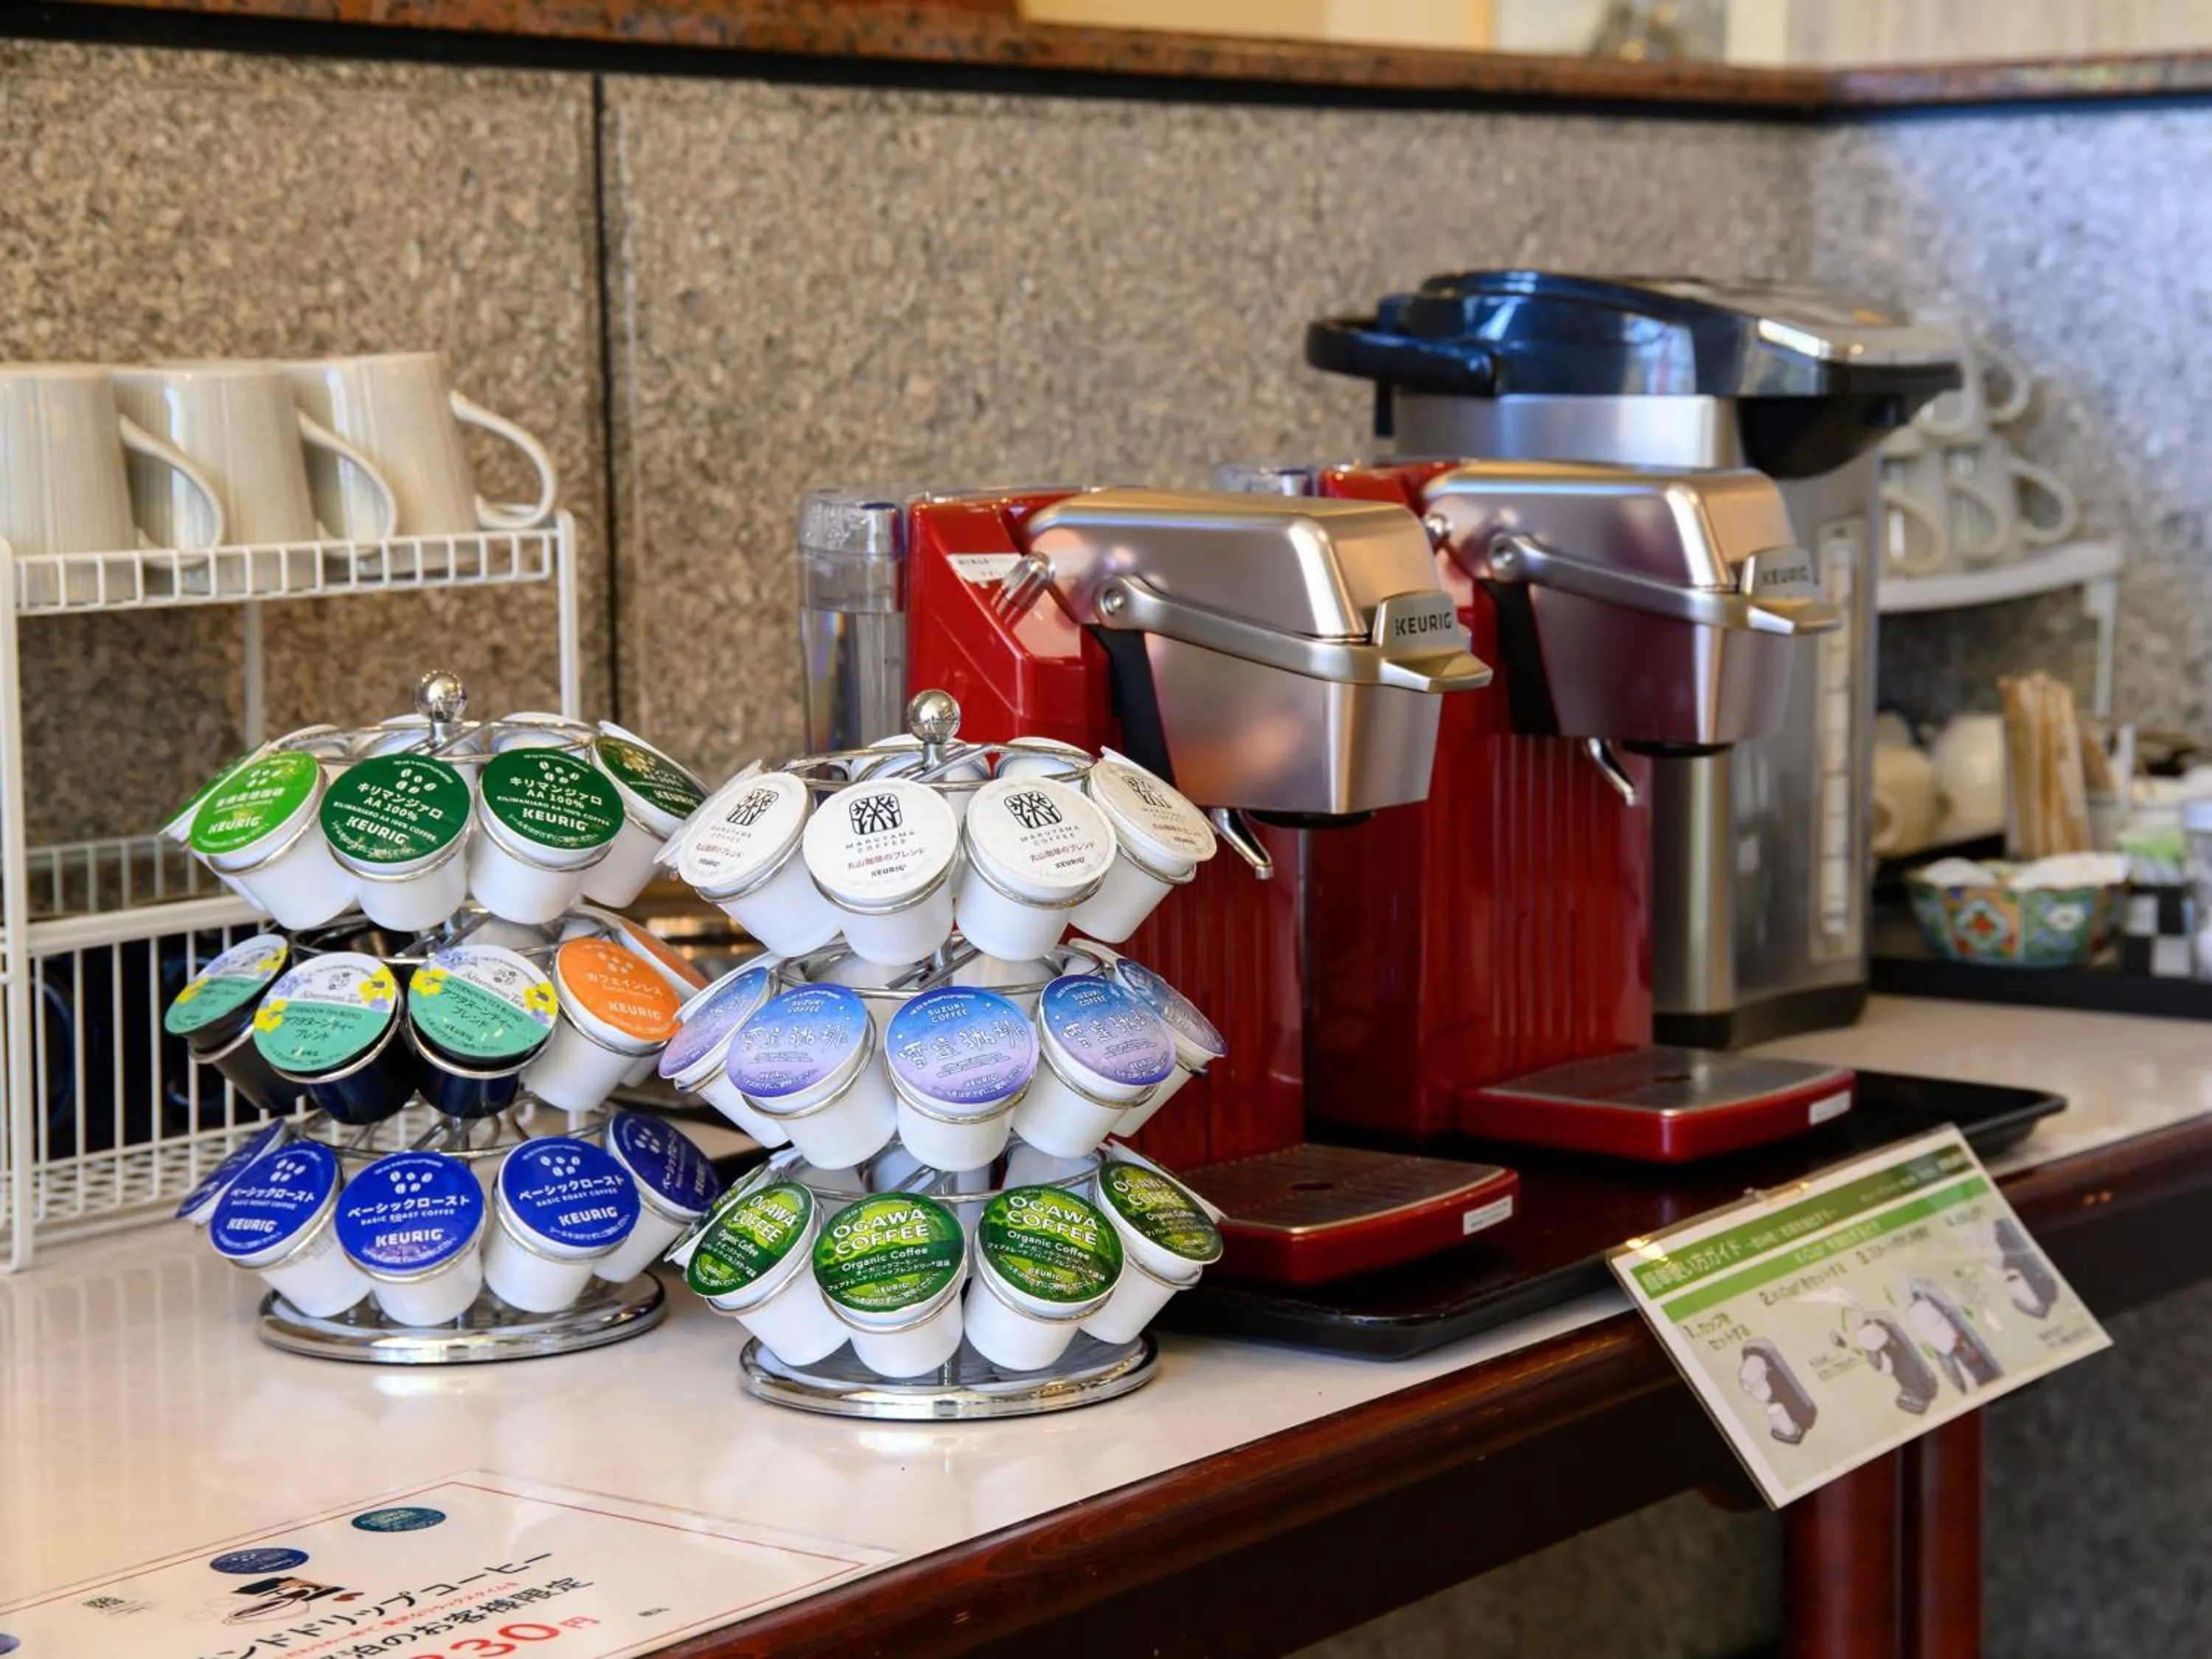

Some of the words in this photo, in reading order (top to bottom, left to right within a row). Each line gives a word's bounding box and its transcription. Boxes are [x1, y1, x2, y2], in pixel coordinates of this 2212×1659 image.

[1395, 612, 1453, 636] KEURIG
[364, 796, 382, 808] AA
[383, 803, 418, 821] 100%
[526, 789, 545, 799] AA
[550, 794, 585, 810] 100%
[208, 815, 263, 835] KEURIG
[346, 815, 410, 844] KEURIG
[522, 807, 589, 832] KEURIG
[586, 972, 664, 997] カフェインレス
[607, 1001, 662, 1020] KEURIG
[927, 1002, 965, 1016] SUZUKI
[931, 1008, 968, 1023] COFFEE
[230, 1186, 315, 1203] ベーシックロースト
[518, 1175, 625, 1200] ベーシックロースト
[347, 1194, 470, 1218] ベーシックロースト
[557, 1206, 619, 1227] KEURIG
[749, 1194, 797, 1228] OGAWA
[1009, 1195, 1098, 1231] OGAWA
[226, 1217, 279, 1233] KEURIG
[732, 1209, 783, 1243] COFFEE
[832, 1208, 927, 1239] OGAWA
[1006, 1210, 1097, 1246] COFFEE
[375, 1228, 444, 1248] KEURIG
[835, 1223, 930, 1255] COFFEE
[1007, 1231, 1051, 1248] Organic
[1054, 1242, 1091, 1261] Coffee
[841, 1255, 887, 1272] Organic
[890, 1247, 929, 1259] Coffee
[873, 1282, 913, 1295] KEURIG
[199, 1553, 552, 1659] ンドドリップコーヒー
